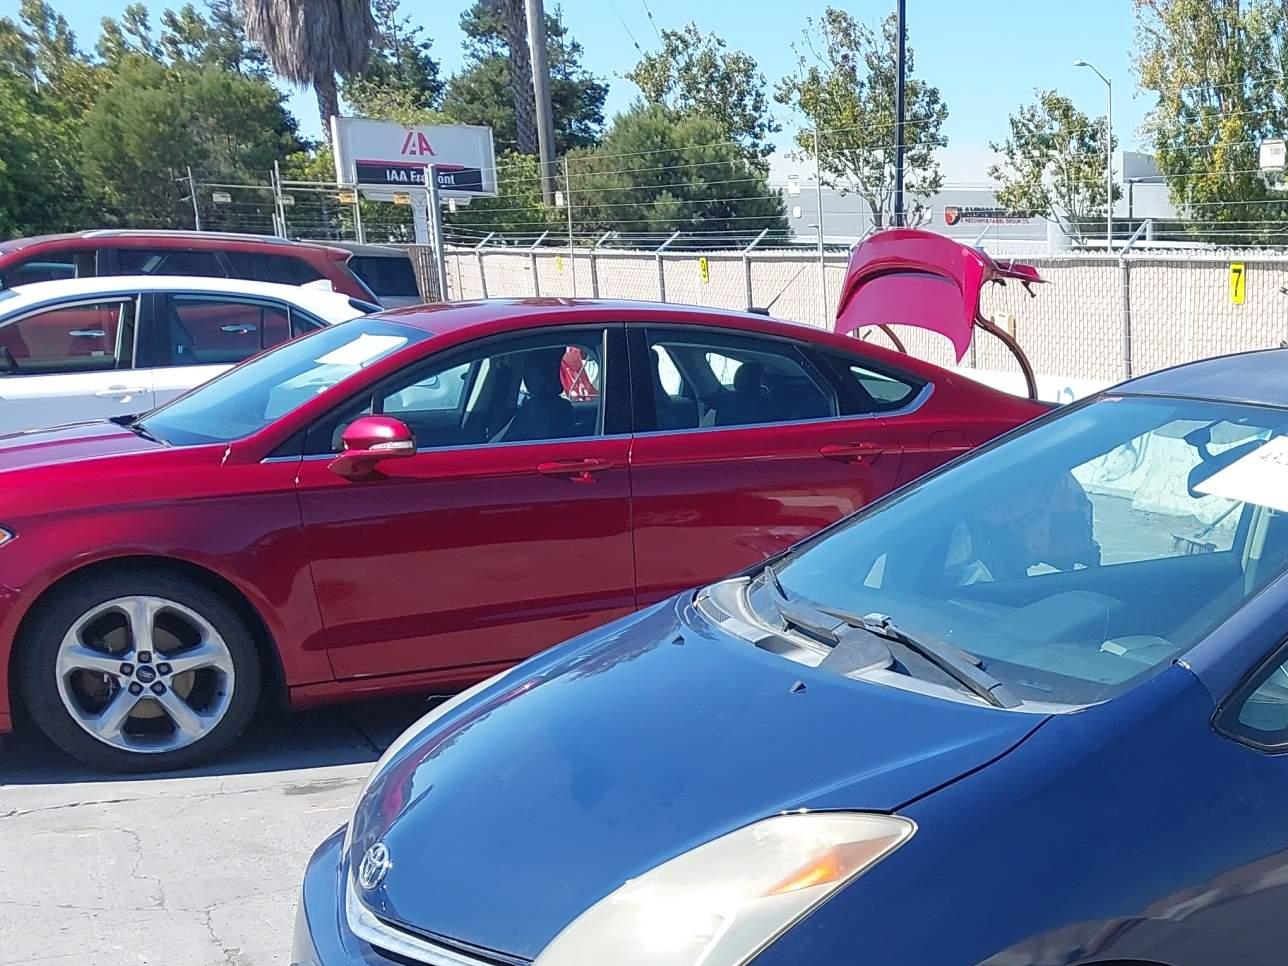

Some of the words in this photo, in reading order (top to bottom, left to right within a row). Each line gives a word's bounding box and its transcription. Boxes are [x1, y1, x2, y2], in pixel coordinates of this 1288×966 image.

[401, 131, 436, 157] IAA
[385, 169, 408, 182] IAA
[409, 170, 456, 185] Freont
[1232, 268, 1243, 297] 7
